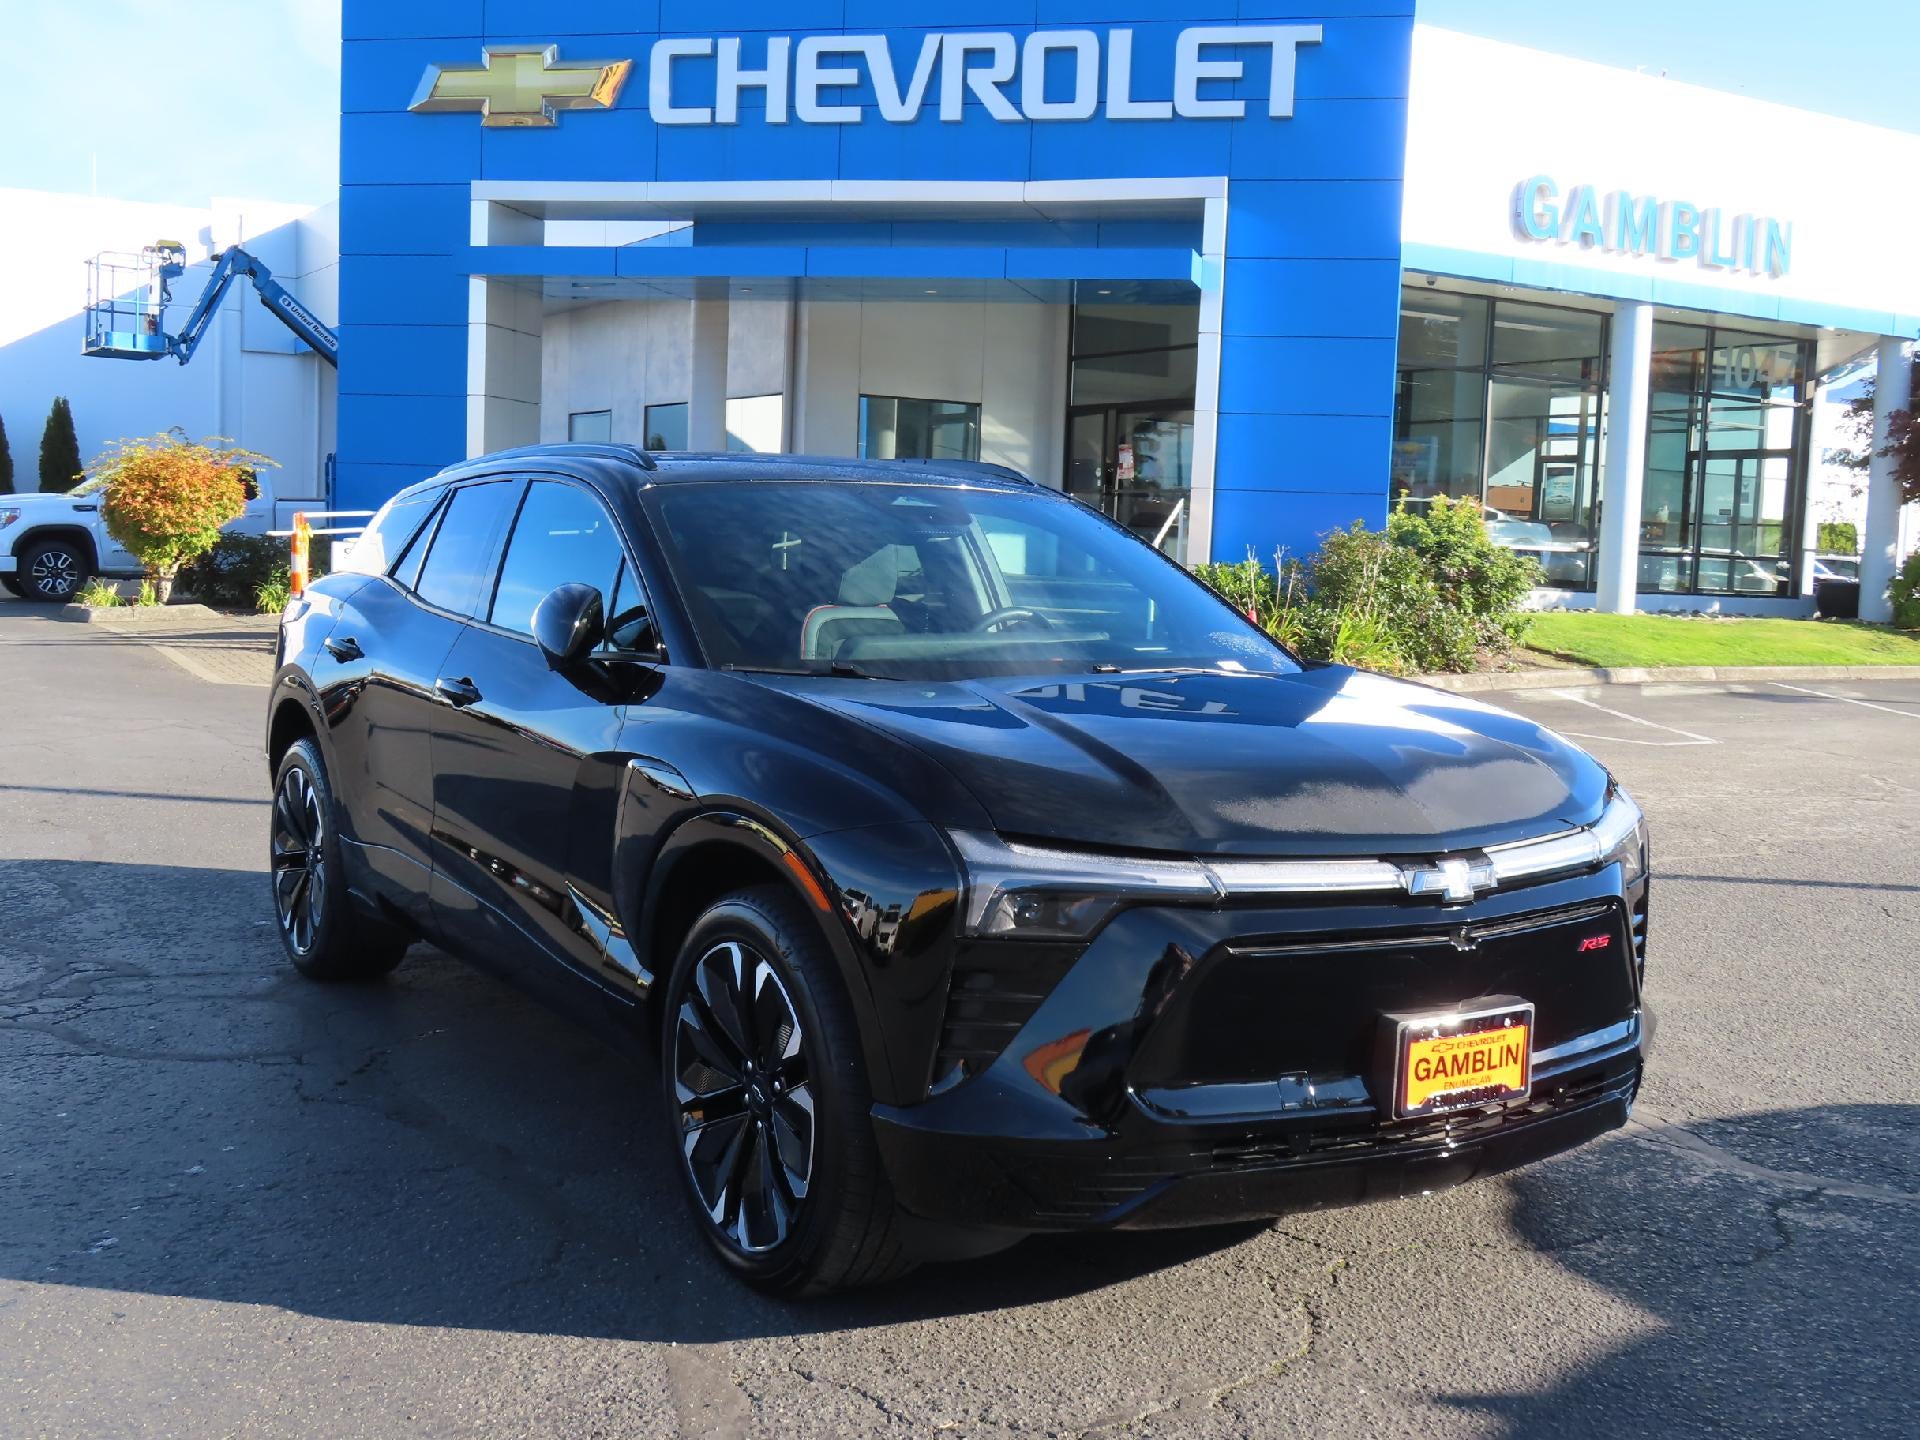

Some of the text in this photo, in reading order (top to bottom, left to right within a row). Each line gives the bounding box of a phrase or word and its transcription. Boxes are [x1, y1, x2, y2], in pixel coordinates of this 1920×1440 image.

[649, 23, 1323, 126] CHEVROLET
[1513, 173, 1793, 278] GAMBLIN
[291, 305, 337, 348] United Rentals
[1719, 344, 1798, 394] 1047
[1577, 935, 1612, 952] RS
[1456, 1034, 1507, 1049] CHEVROLET
[1414, 1043, 1520, 1081] GAMBLIN
[1443, 1075, 1492, 1090] ENUMCLAW
